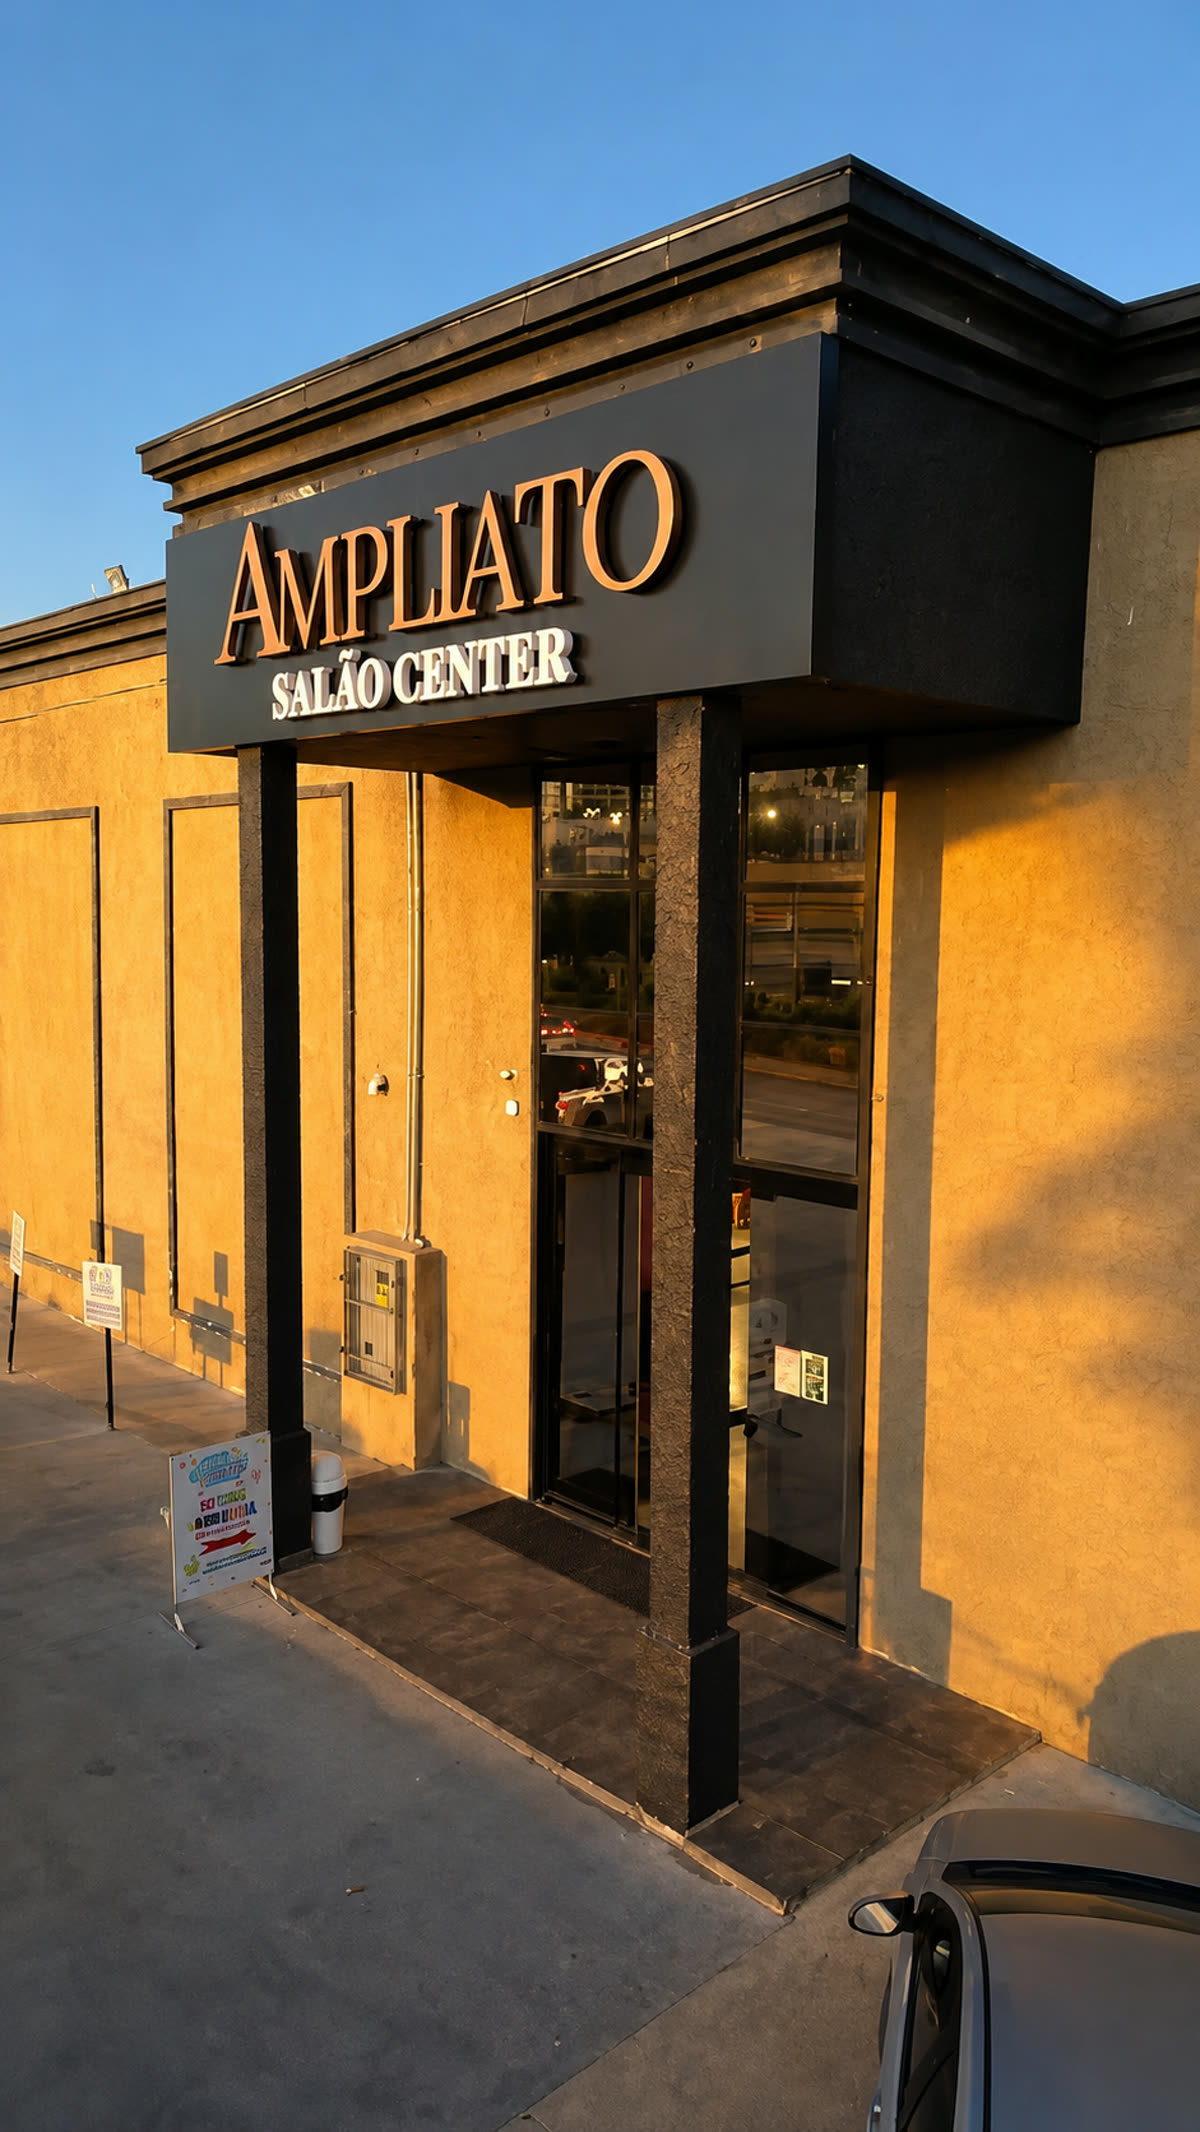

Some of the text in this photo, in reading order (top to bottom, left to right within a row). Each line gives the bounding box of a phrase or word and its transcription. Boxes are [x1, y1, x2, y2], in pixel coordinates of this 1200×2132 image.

[214, 450, 680, 665] AMPLIATO
[272, 627, 577, 720] SALÃO CENTER
